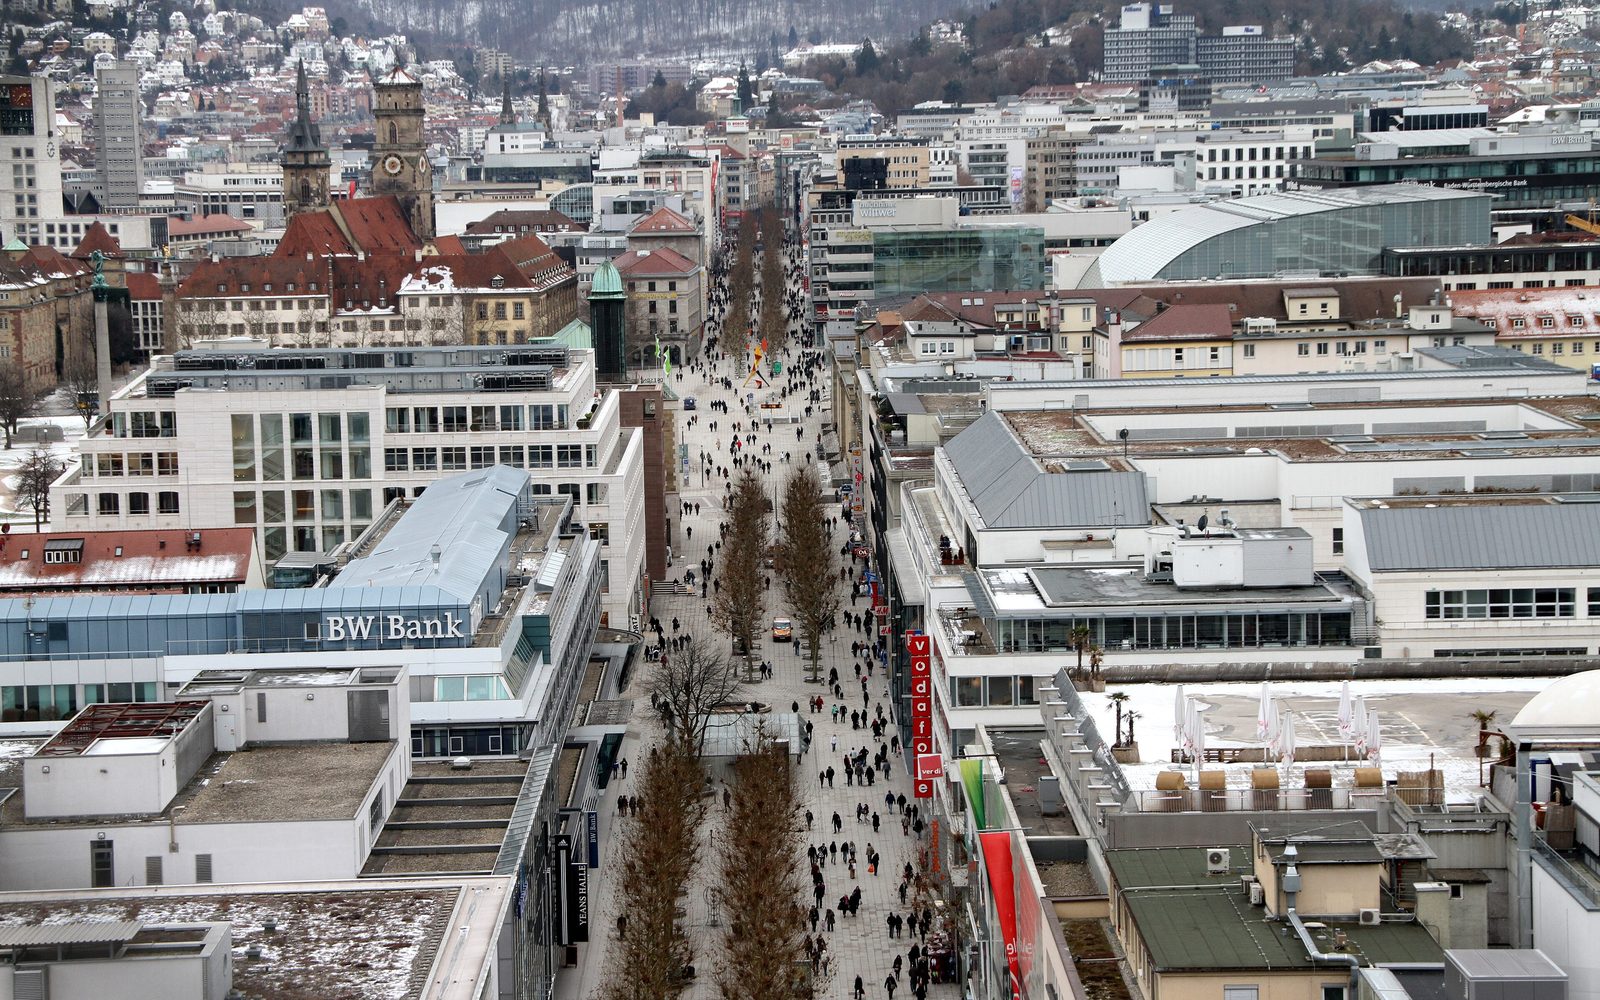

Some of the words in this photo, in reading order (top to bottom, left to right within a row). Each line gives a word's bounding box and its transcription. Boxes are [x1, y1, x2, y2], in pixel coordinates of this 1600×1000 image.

[1552, 136, 1566, 145] BW
[1568, 134, 1590, 144] Bank
[860, 208, 897, 217] wittwer
[326, 615, 375, 641] BW
[387, 612, 464, 639] Bank
[914, 640, 929, 794] vodafoe
[578, 864, 587, 895] HALLE
[579, 896, 588, 925] YEANS
